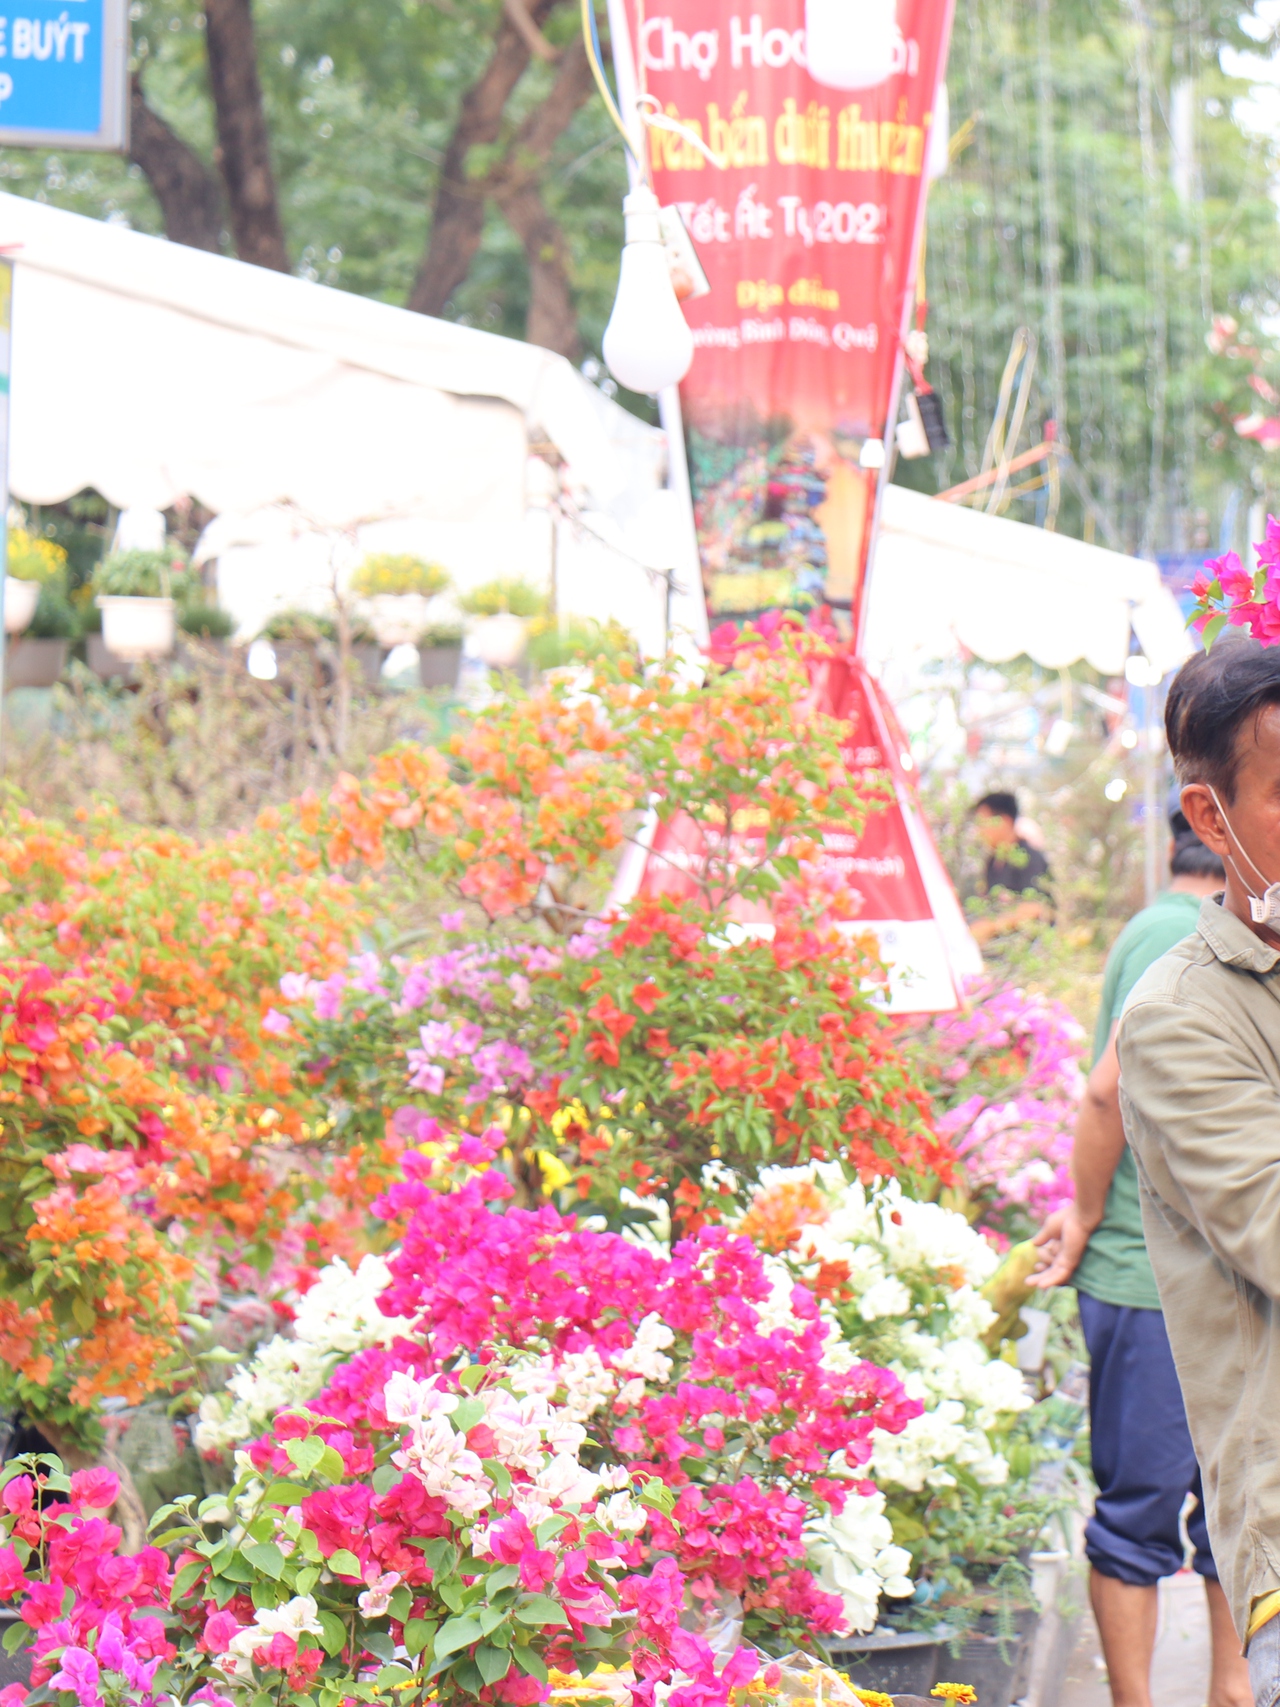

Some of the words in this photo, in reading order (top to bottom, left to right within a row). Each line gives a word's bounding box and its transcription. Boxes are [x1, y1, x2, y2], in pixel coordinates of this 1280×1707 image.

[12, 11, 90, 63] BUÝT
[640, 16, 719, 81] Chợ
[679, 197, 732, 245] Tết
